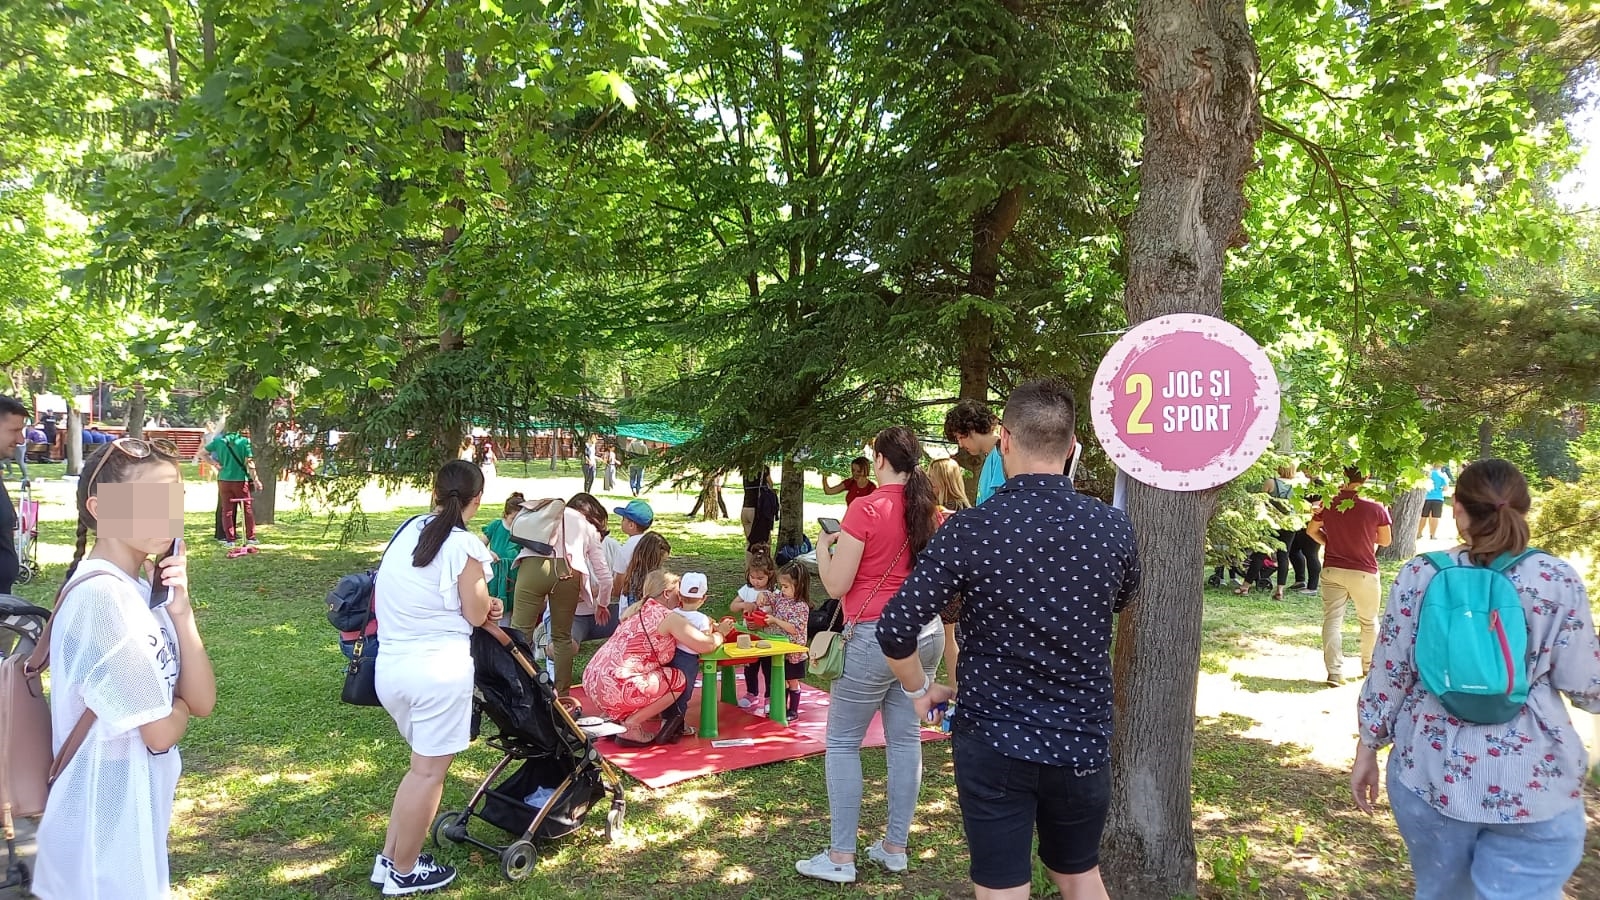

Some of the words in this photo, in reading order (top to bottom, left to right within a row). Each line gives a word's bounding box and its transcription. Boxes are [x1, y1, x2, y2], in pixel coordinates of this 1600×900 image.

[1162, 370, 1204, 398] JOC
[1125, 373, 1155, 435] 2
[1162, 404, 1232, 432] SPORT
